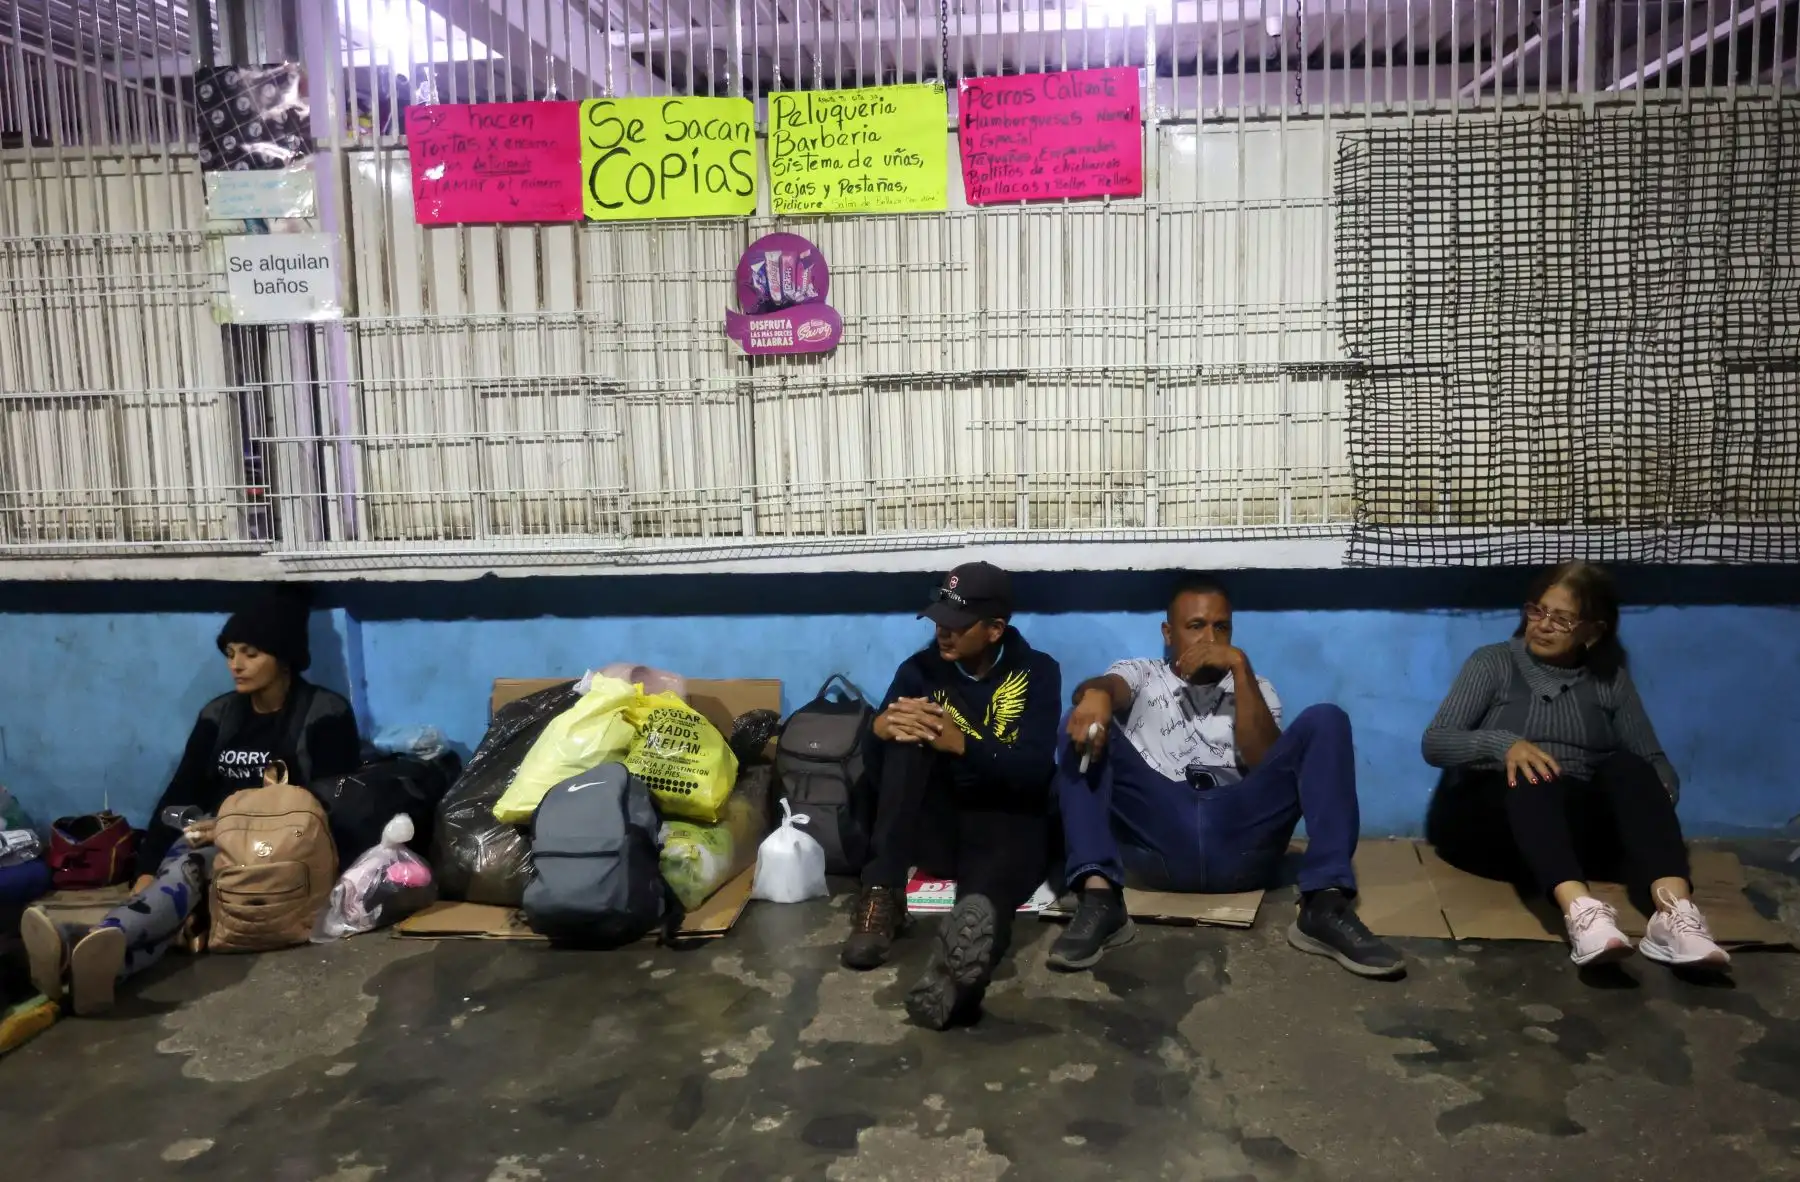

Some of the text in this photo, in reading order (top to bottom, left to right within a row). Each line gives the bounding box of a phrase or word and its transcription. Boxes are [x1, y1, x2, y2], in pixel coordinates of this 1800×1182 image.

[965, 86, 1036, 109] Perros
[411, 105, 534, 135] Se hacen
[772, 93, 897, 131] Peluqueria
[588, 100, 750, 149] Se Sacan
[772, 124, 882, 158] Barberia
[965, 136, 974, 153] y
[848, 149, 873, 169] de
[884, 147, 924, 169] uñas,
[1030, 164, 1045, 175] de
[824, 183, 831, 199] y
[229, 253, 331, 276] Se alquilan
[253, 277, 309, 295] baños
[750, 319, 793, 330] DISFRUTA
[797, 323, 832, 342] Savoy
[750, 337, 794, 347] PALABRAS
[648, 767, 662, 775] SUS
